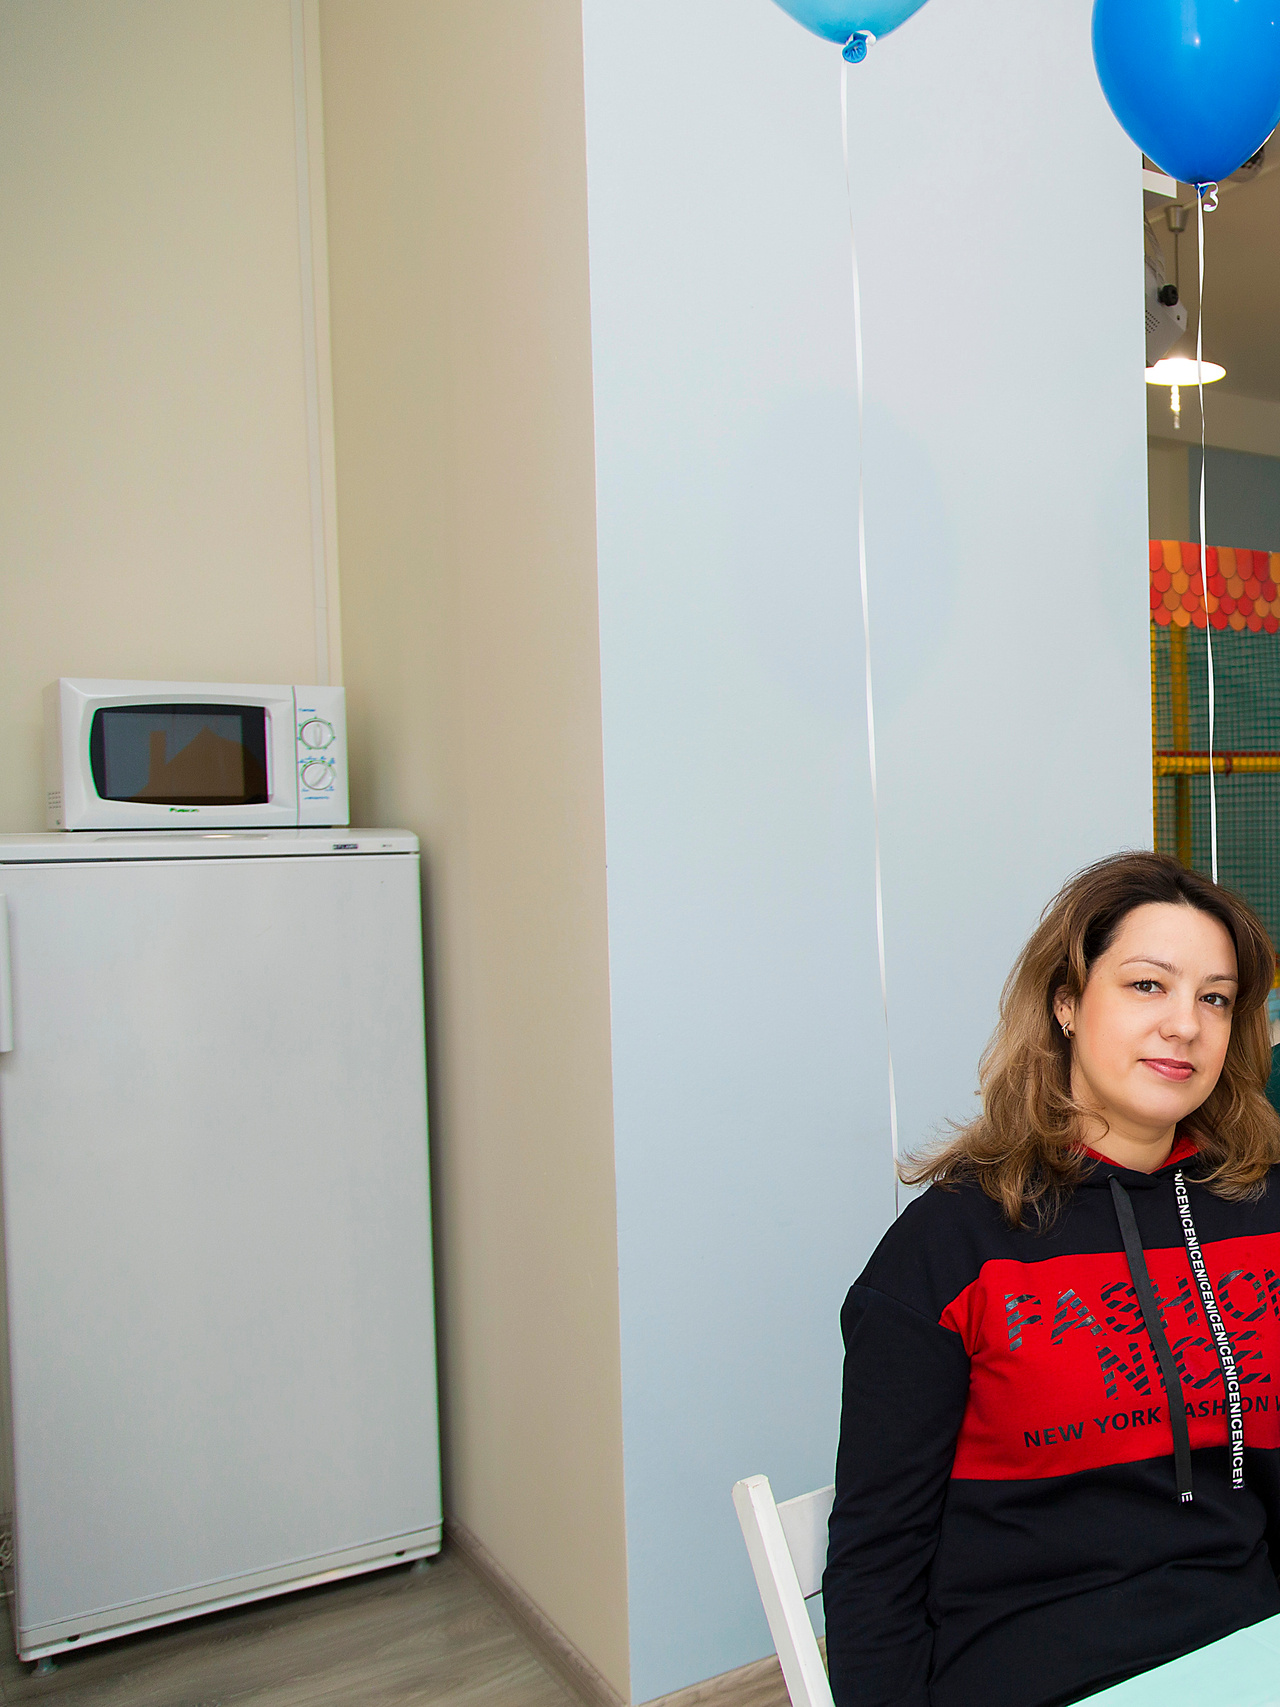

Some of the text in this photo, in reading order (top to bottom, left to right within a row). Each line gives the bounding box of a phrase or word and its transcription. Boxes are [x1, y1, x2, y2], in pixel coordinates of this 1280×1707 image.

[1023, 1422, 1085, 1448] NEW
[1093, 1406, 1162, 1434] YORK
[1170, 1395, 1269, 1421] ASHON
